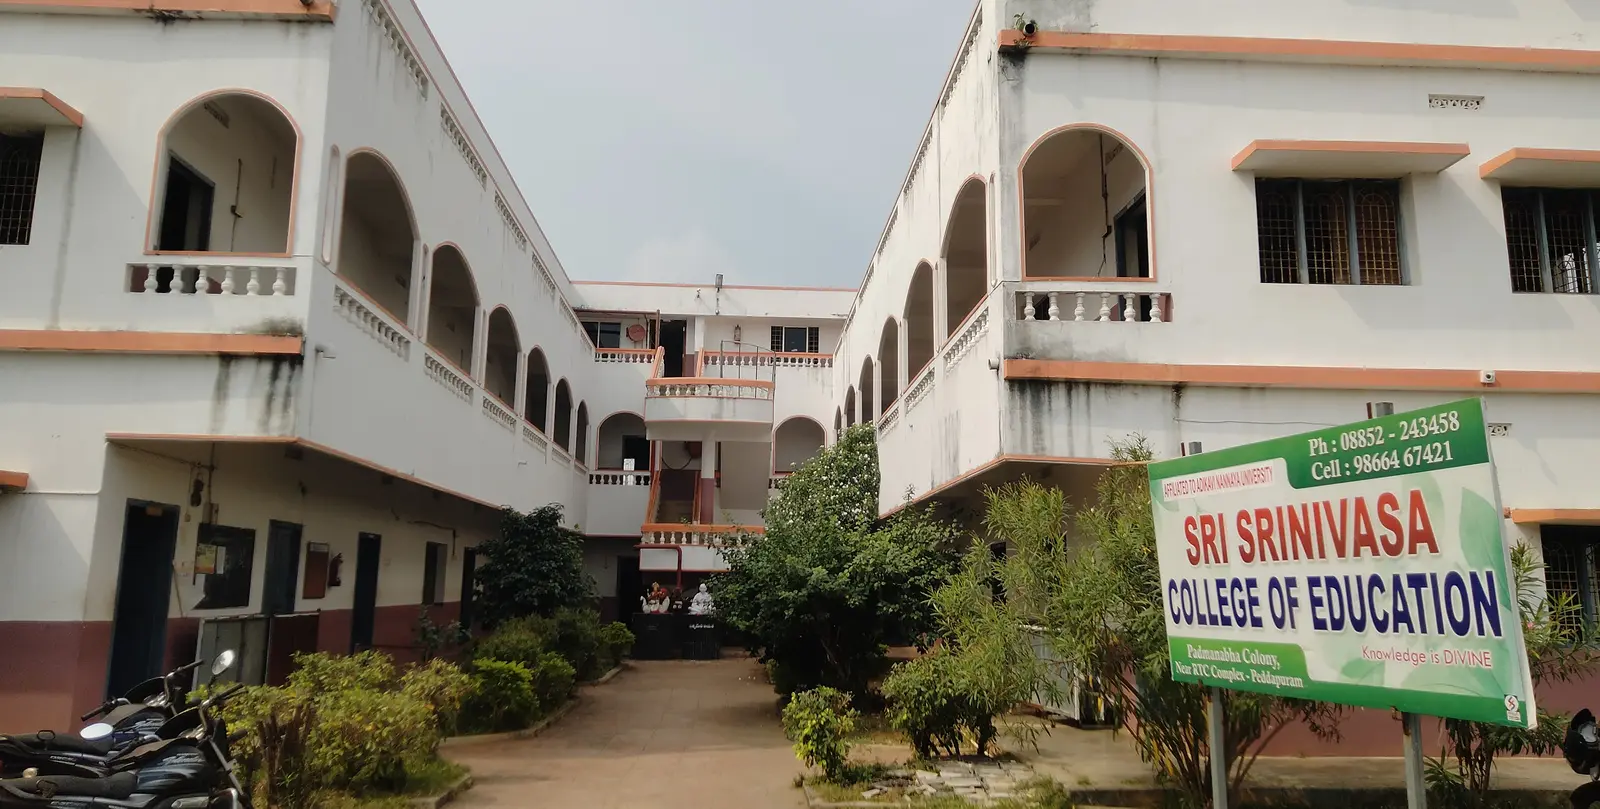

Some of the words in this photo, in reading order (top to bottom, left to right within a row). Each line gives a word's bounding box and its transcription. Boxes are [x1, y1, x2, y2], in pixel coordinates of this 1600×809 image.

[1308, 437, 1329, 456] Ph
[1331, 439, 1337, 453] :
[1340, 425, 1385, 451] 08852
[1399, 410, 1460, 441] 243458
[1311, 458, 1342, 481] Cell
[1344, 462, 1351, 476] :
[1353, 449, 1401, 475] 98664
[1403, 440, 1453, 467] 67421
[1164, 480, 1188, 498] AFFILIATED
[1189, 478, 1196, 494] TO
[1241, 466, 1273, 486] UNIVERSITY
[1183, 512, 1229, 567] SRI
[1236, 489, 1440, 565] SRINIVASA
[1168, 576, 1264, 629] COLLEGE
[1268, 575, 1299, 630] OF
[1306, 570, 1503, 637] EDUCATION
[1175, 661, 1192, 675] Near
[1192, 663, 1211, 677] RTC
[1210, 665, 1246, 683] Complex
[1250, 668, 1304, 688] Peddapuram
[1186, 644, 1242, 663] Padmanabha
[1242, 648, 1281, 670] Colony,
[1361, 646, 1426, 666] Knowledge
[1431, 650, 1440, 664] is
[1443, 649, 1492, 667] DIVINE
